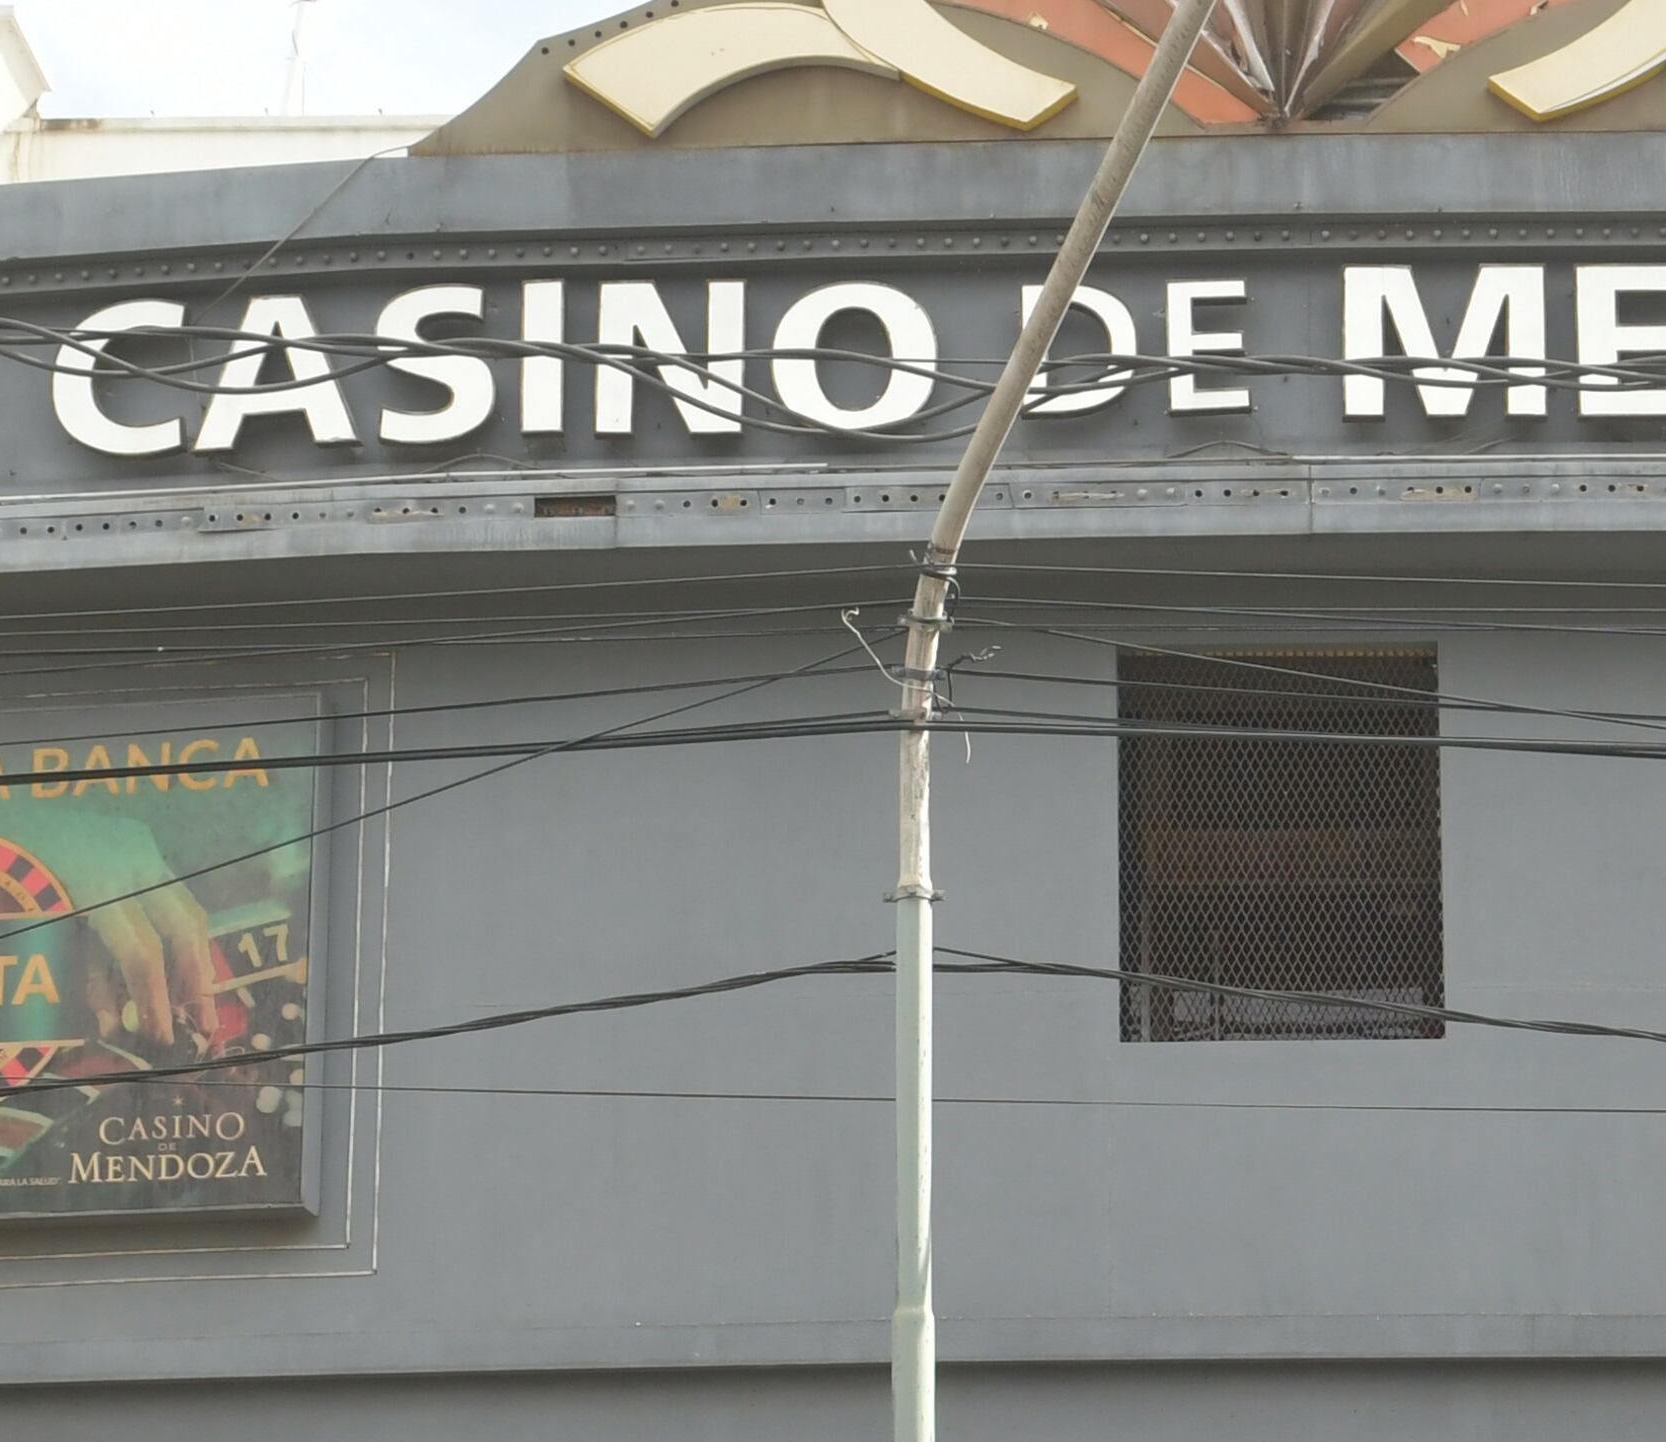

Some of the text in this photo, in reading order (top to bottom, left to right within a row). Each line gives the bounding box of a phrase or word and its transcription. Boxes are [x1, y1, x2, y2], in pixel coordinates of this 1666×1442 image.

[50, 279, 937, 457] CASINO
[1020, 279, 1252, 417] DE
[30, 737, 270, 799] BANCA
[237, 924, 289, 968] 17
[99, 1112, 245, 1146] CASINO
[157, 1142, 177, 1152] DE
[67, 1145, 268, 1185] MENDOZA
